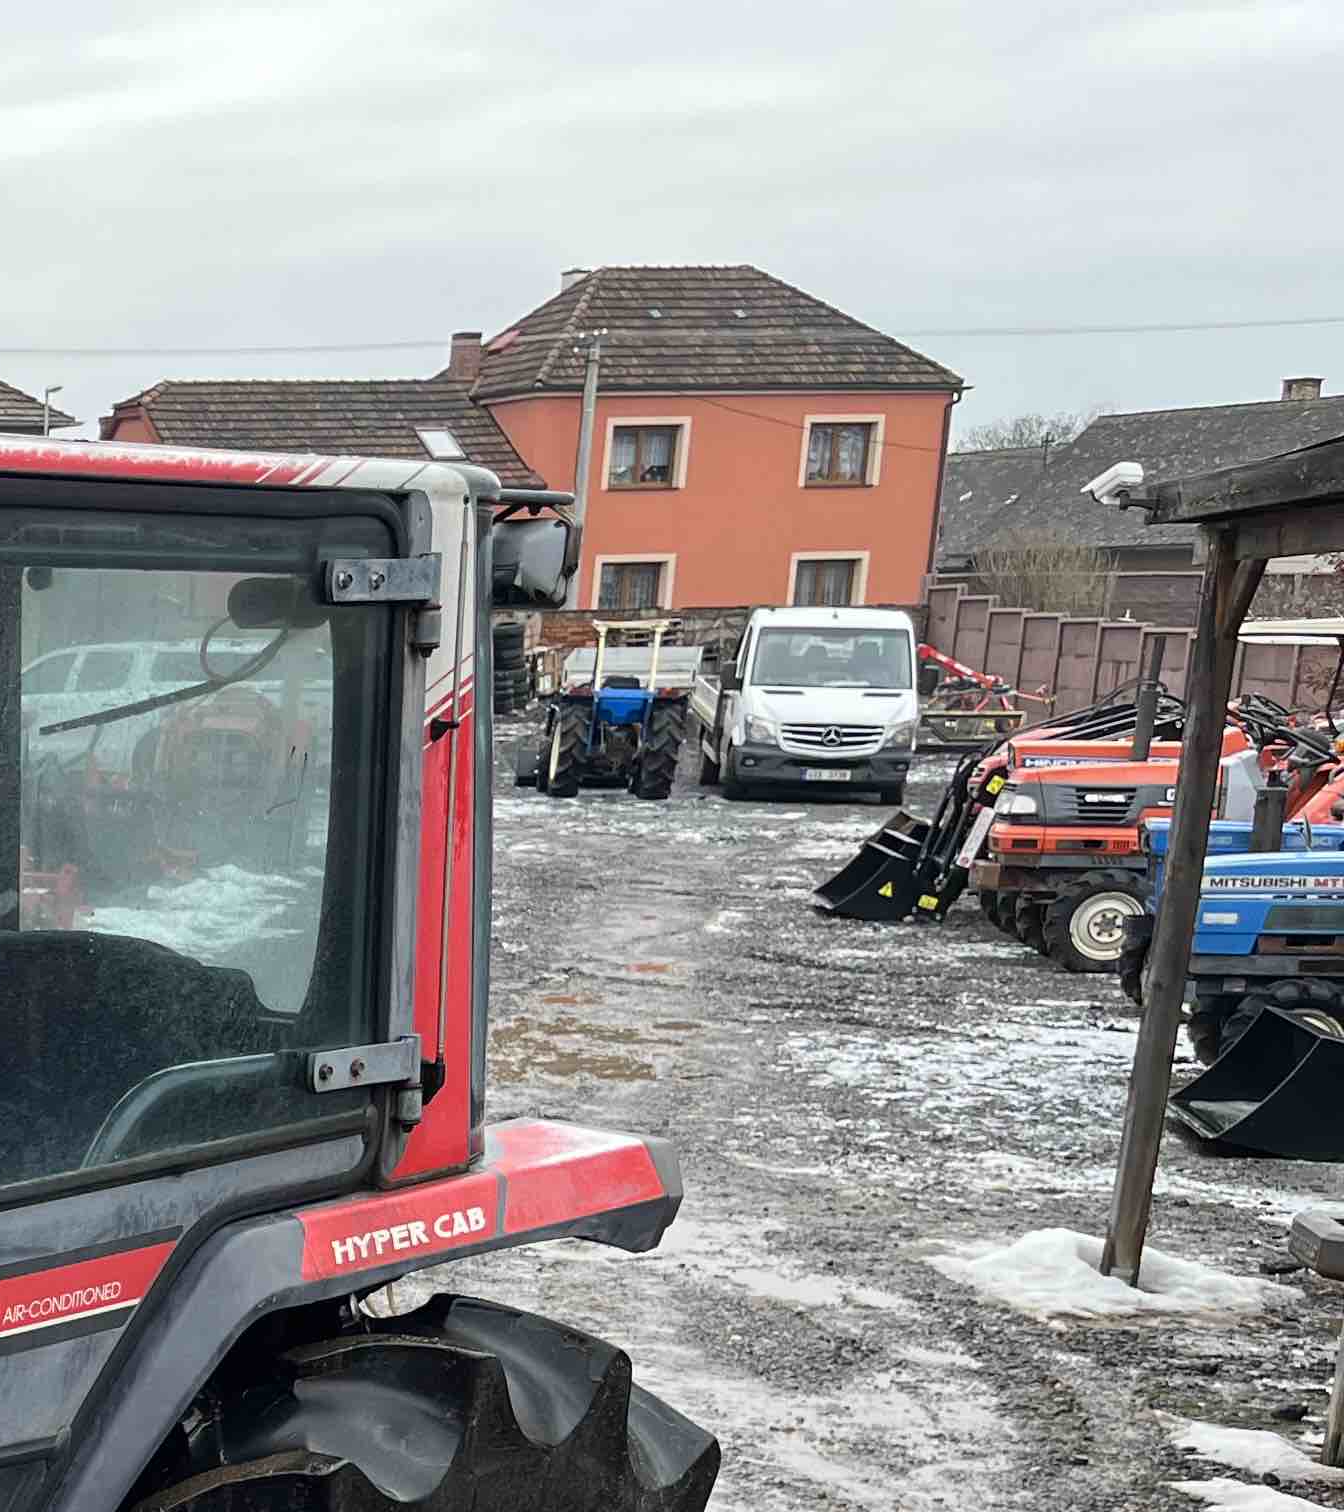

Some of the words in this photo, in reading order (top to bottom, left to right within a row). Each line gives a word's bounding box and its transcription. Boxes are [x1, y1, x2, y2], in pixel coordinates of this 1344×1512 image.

[1210, 877, 1306, 888] MITSUBISHI
[331, 1221, 430, 1265] HYPER
[433, 1206, 486, 1238] CAB
[2, 1281, 121, 1325] AIR-CONDITIONED
